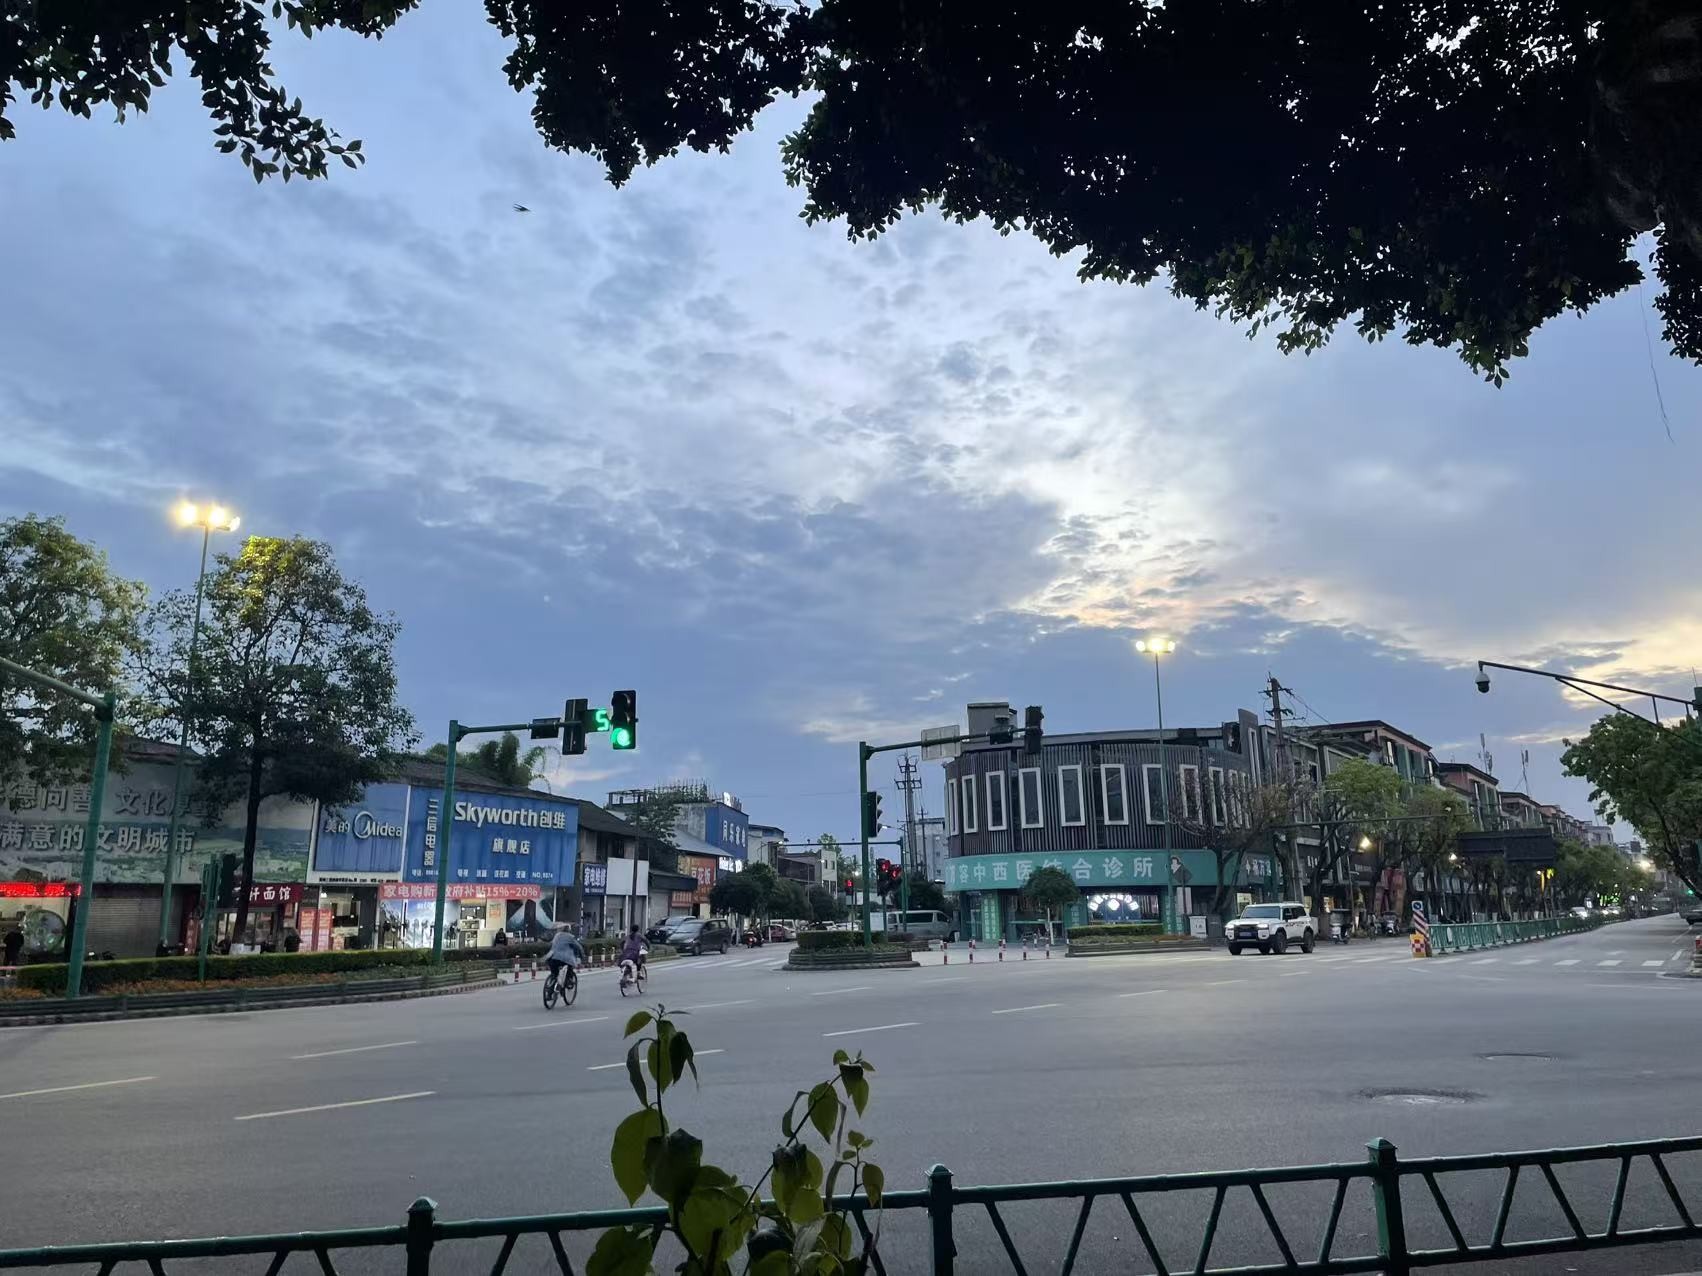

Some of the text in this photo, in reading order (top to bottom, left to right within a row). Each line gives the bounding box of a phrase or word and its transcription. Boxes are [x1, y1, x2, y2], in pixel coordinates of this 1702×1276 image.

[596, 709, 609, 731] 5
[325, 815, 402, 838] 美的 Midea
[454, 801, 566, 830] Skyworth 创维
[423, 797, 439, 866] 三信电器
[492, 837, 531, 855] 旗舰店
